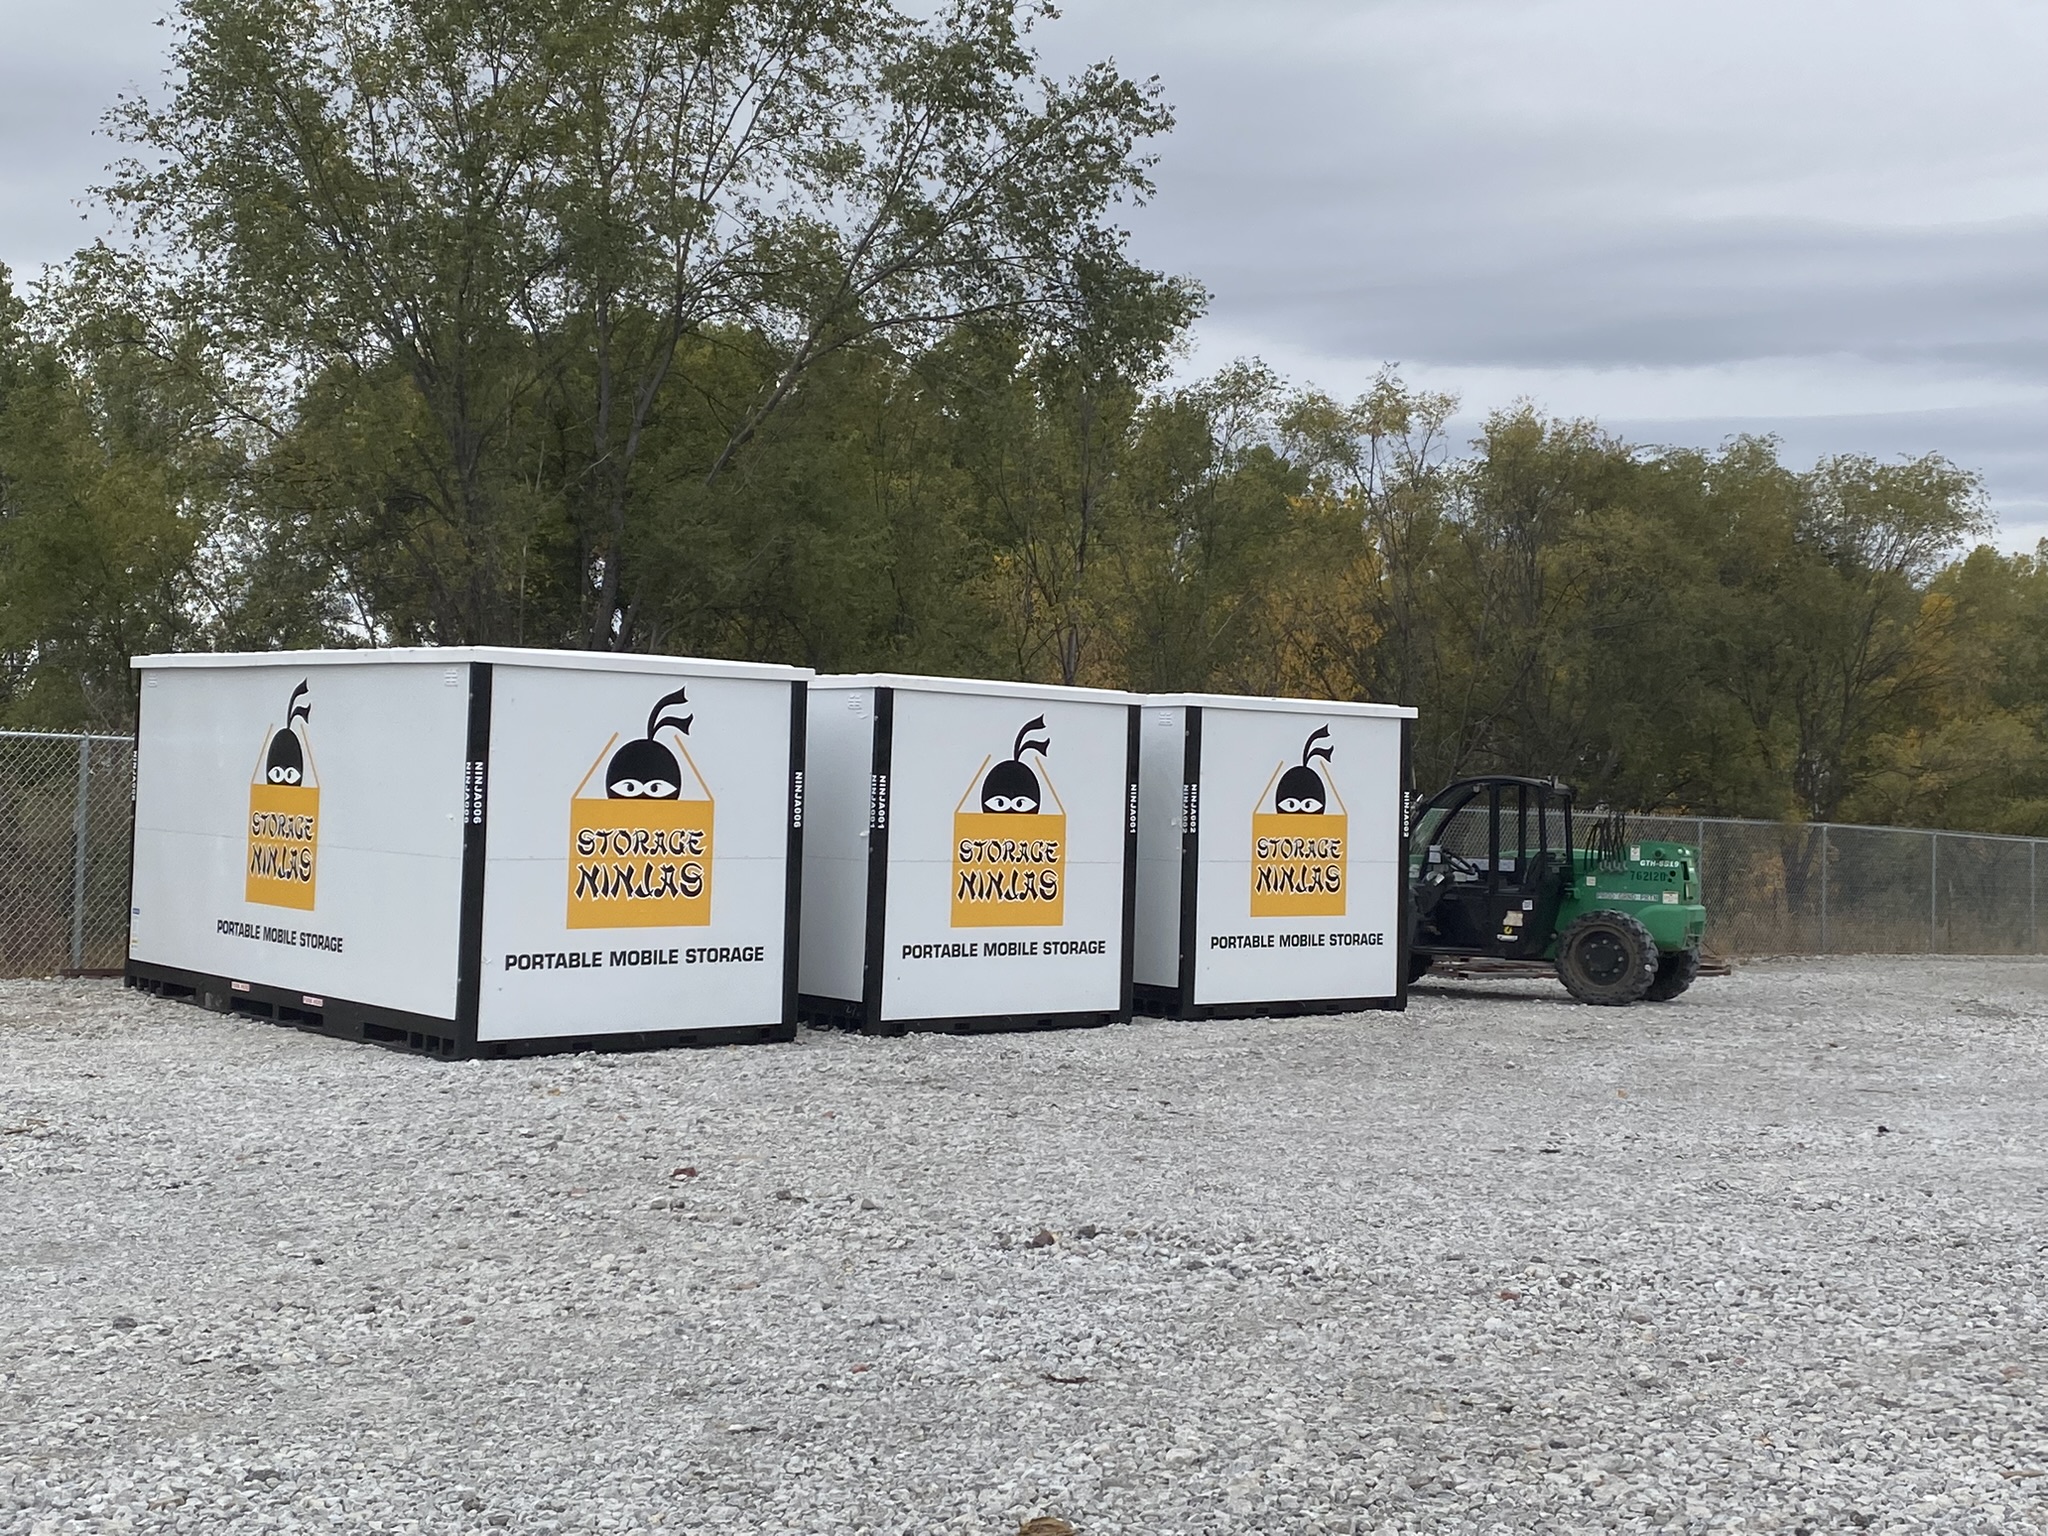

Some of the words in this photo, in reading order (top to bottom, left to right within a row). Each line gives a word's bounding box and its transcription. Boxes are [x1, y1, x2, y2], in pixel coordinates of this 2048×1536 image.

[473, 761, 484, 824] NINJA006
[793, 771, 803, 828] NINJA006
[869, 774, 877, 828] NINJA001
[877, 775, 887, 829] NINJA001
[1129, 784, 1137, 833] NINJA001
[1189, 784, 1198, 833] NINJA002
[252, 811, 314, 842] STORAGE
[576, 828, 706, 856] STORAGE
[250, 844, 313, 883] NINJAS
[958, 839, 1060, 864] STORAGE
[1257, 837, 1342, 860] STORAGE
[574, 861, 704, 899] NINJAS
[957, 869, 1058, 901] NINJAS
[1255, 864, 1341, 893] NINJAS
[216, 919, 261, 940] PORTABLE
[263, 926, 297, 946] MOBILE
[299, 932, 343, 953] STORAGE
[902, 943, 978, 959] PORTABLE
[983, 941, 1038, 957] MOBILE
[1043, 940, 1106, 955] STORAGE
[1210, 934, 1275, 950] PORTABLE
[1279, 933, 1325, 948] MOBILE
[1329, 932, 1384, 946] STORAGE
[505, 951, 602, 971] PORTABLE
[609, 948, 679, 967] MOBILE
[685, 946, 764, 964] STORAGE
